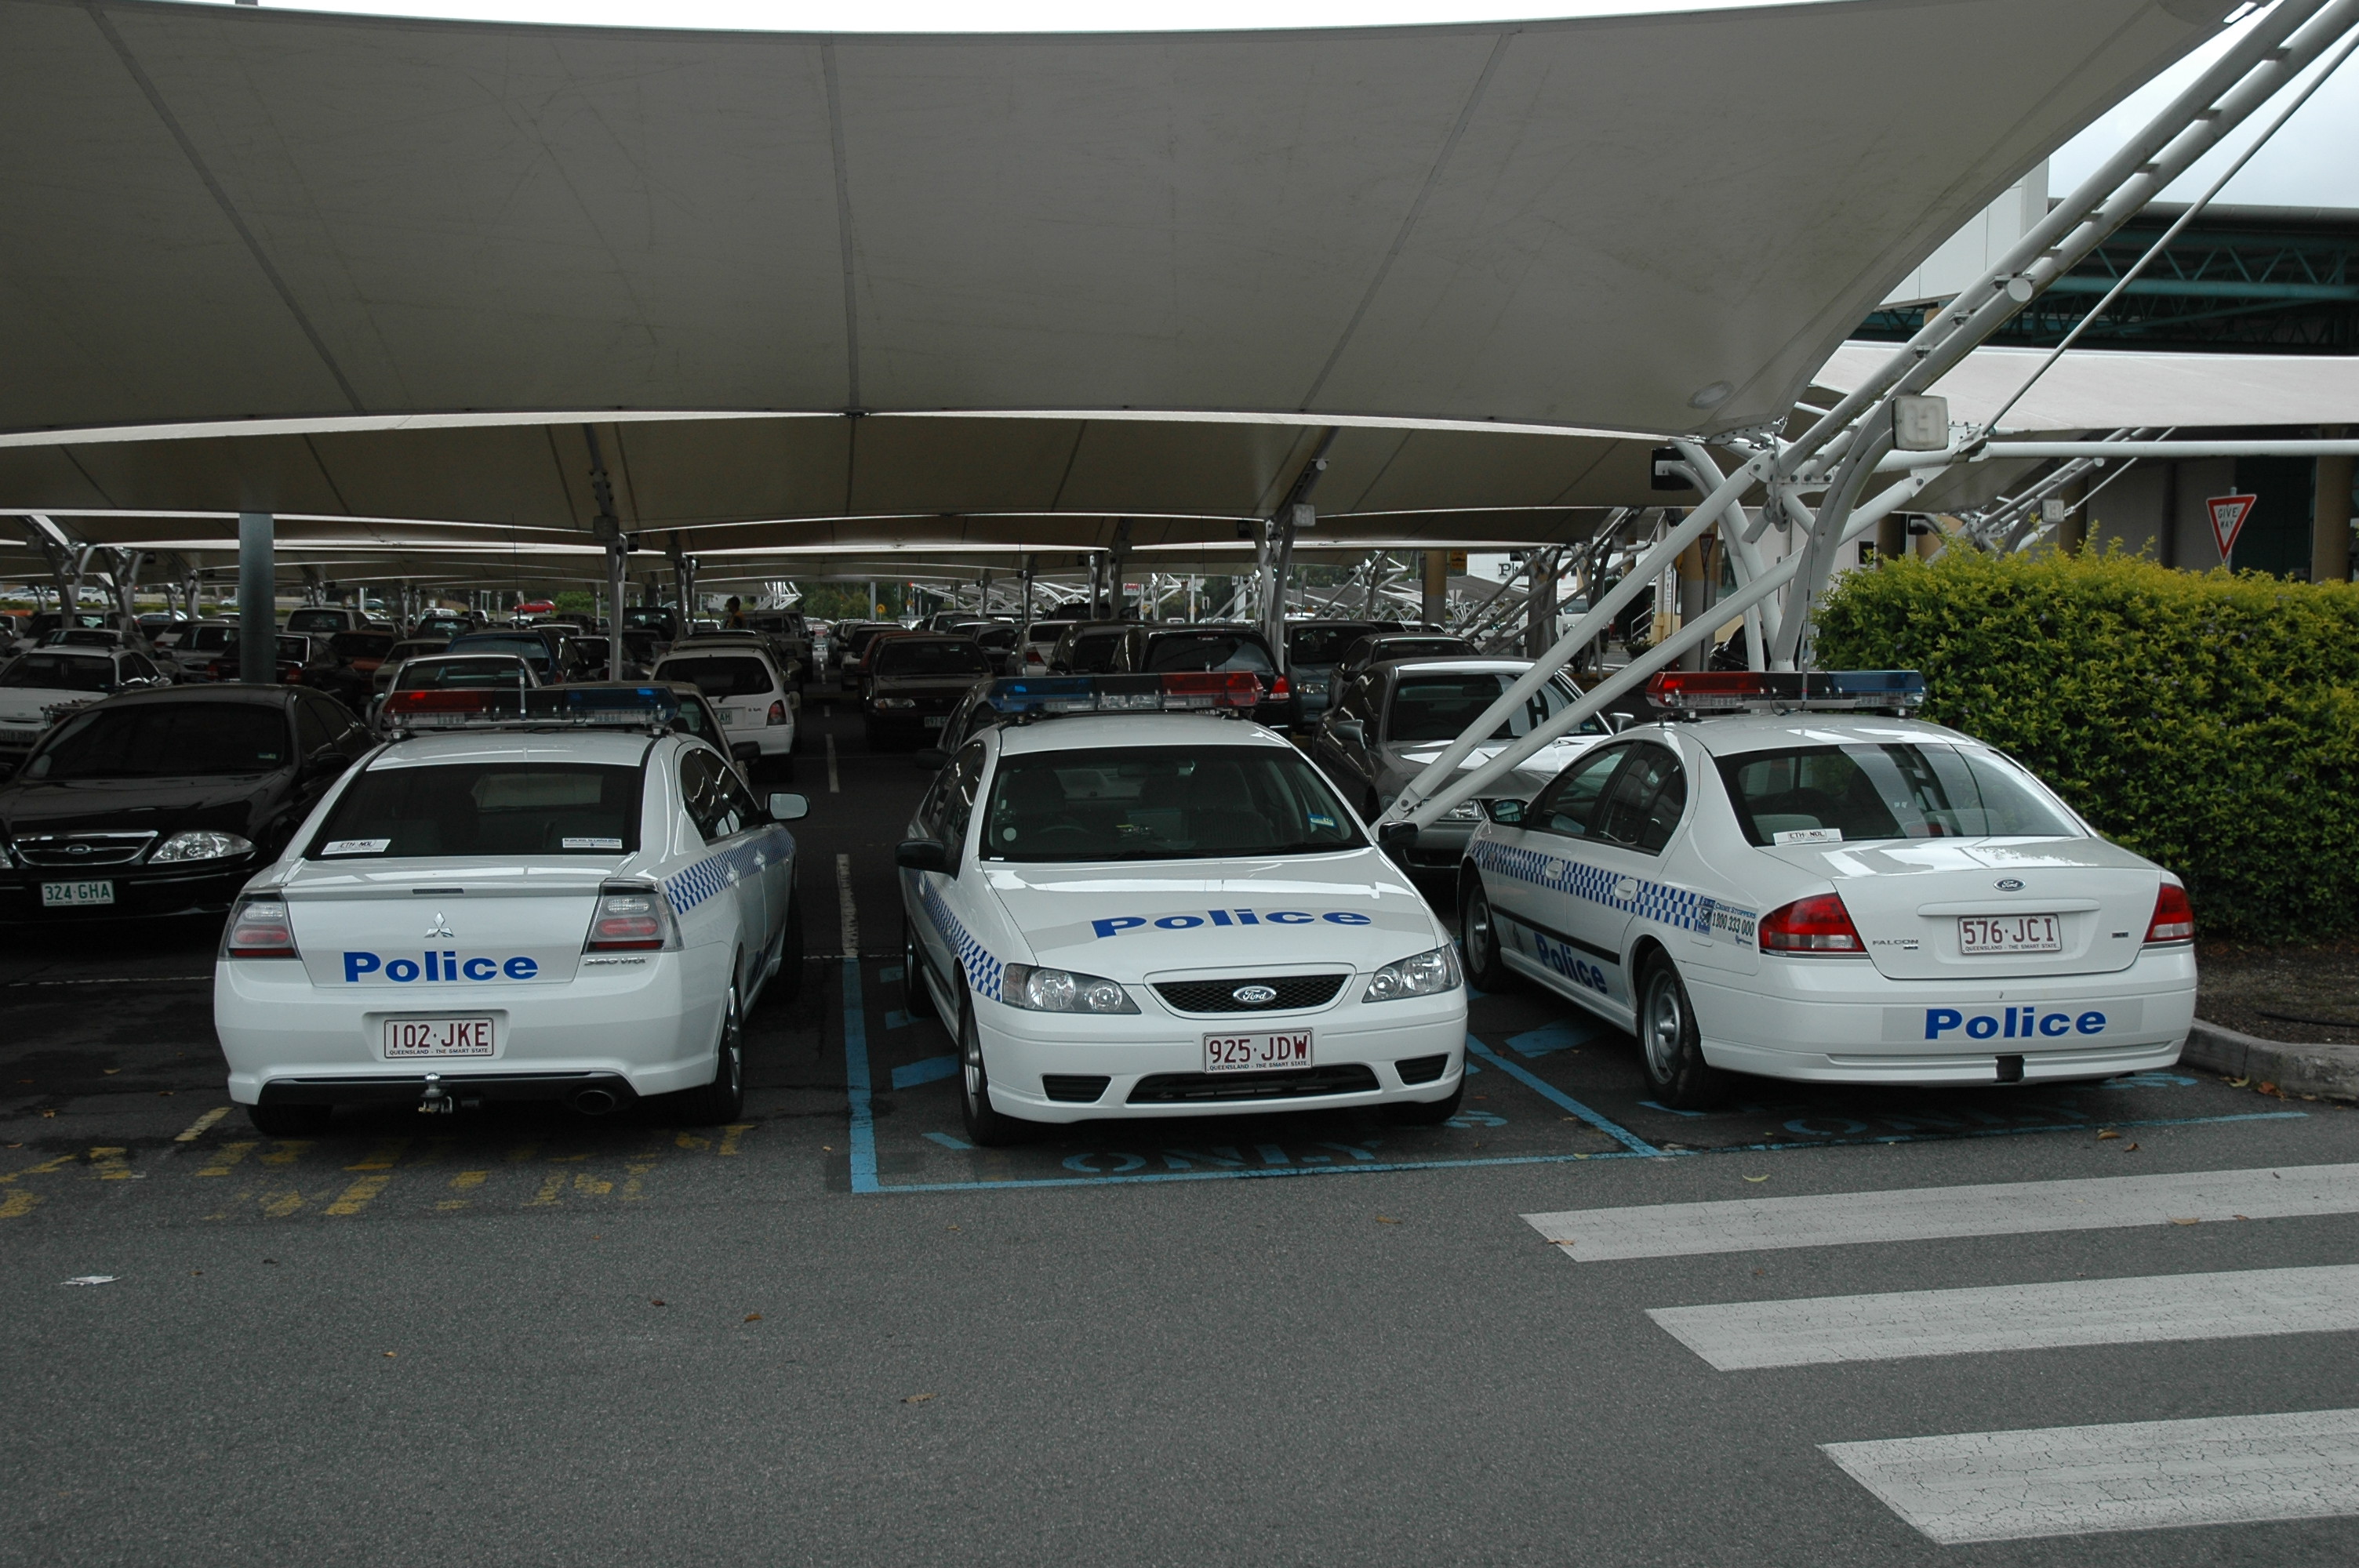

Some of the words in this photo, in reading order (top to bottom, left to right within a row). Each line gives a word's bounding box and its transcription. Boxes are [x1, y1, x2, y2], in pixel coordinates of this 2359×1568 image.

[2218, 507, 2238, 518] GIVE
[2220, 520, 2234, 528] WAY
[1091, 909, 1372, 938] Police
[1712, 912, 1728, 930] 1800
[1728, 915, 1741, 934] 333
[1741, 919, 1755, 937] 000
[1730, 906, 1757, 919] STOPPERS
[343, 950, 539, 983] Police
[1533, 931, 1608, 995] Police
[1925, 1007, 2106, 1040] Police
[1062, 1140, 1384, 1173] ONLY
